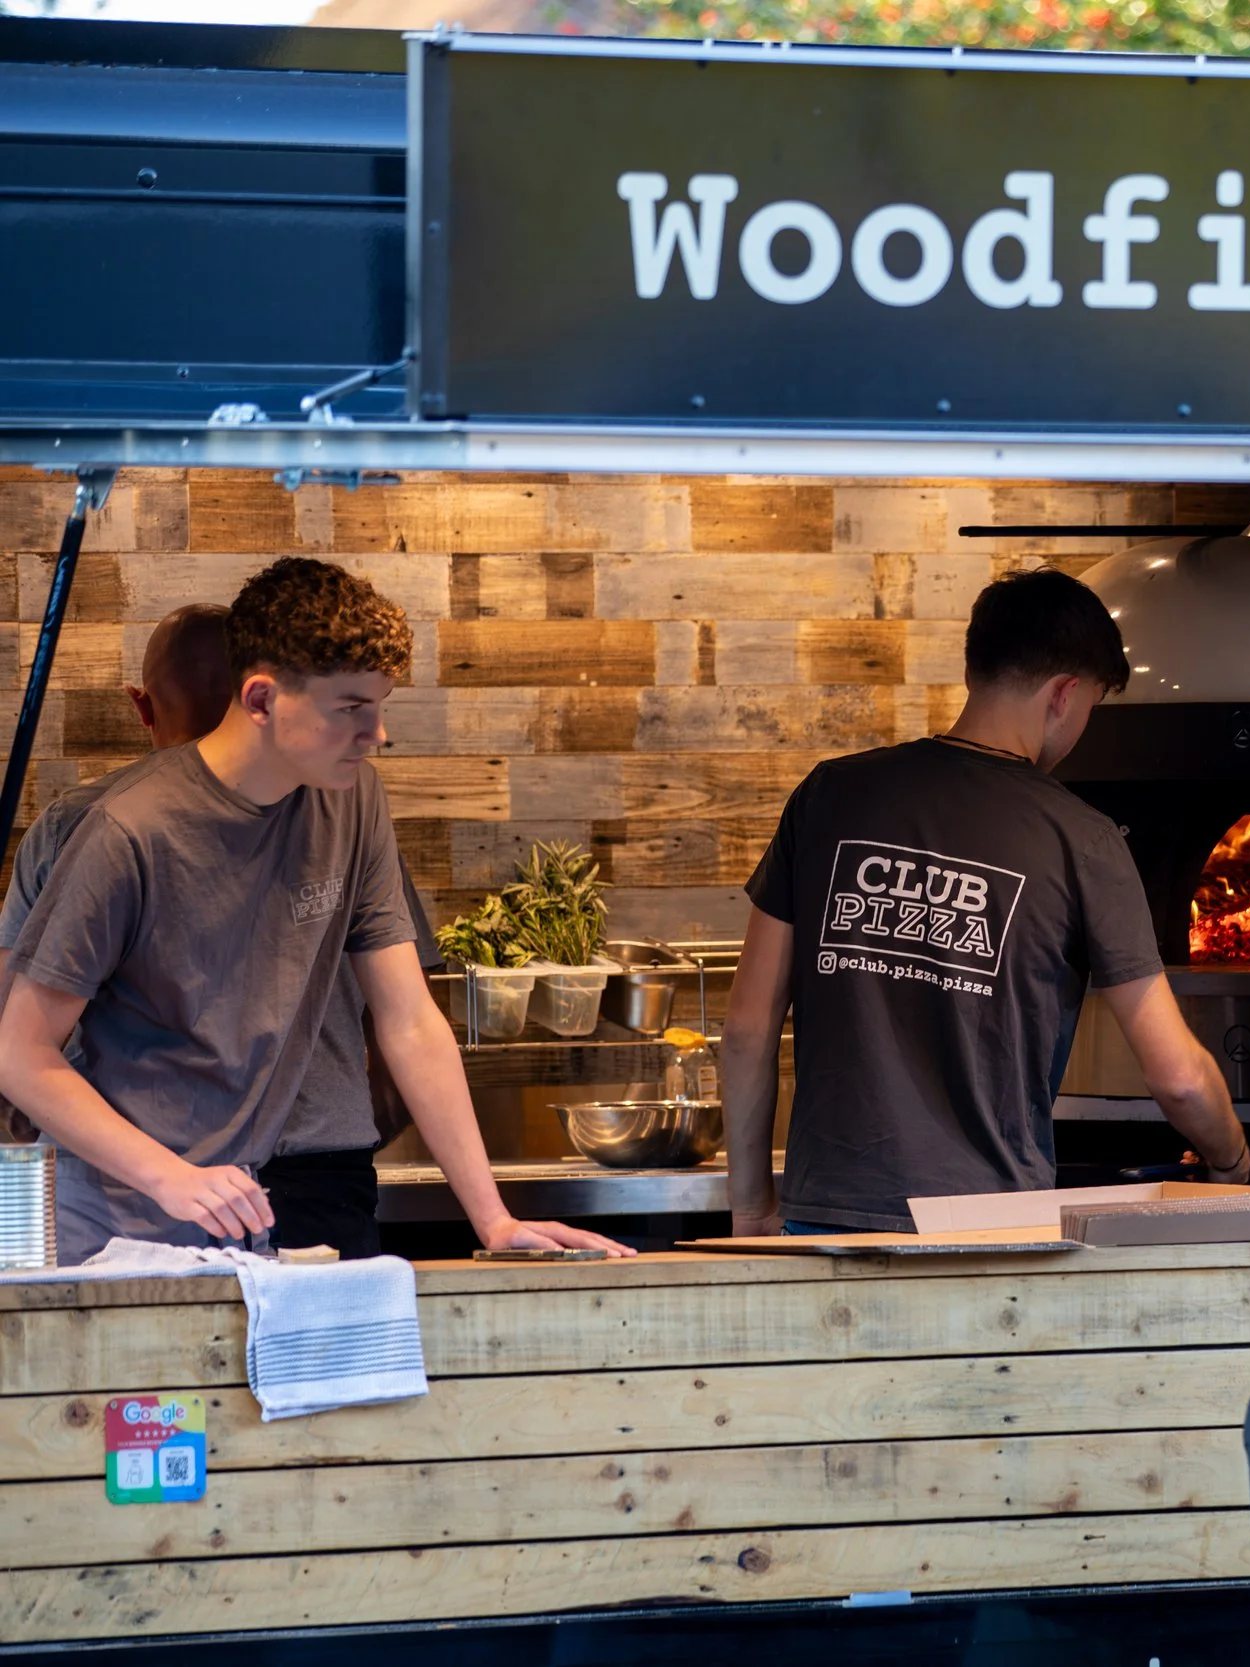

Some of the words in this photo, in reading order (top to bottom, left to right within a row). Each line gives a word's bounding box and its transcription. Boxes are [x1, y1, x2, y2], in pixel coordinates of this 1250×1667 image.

[856, 856, 988, 912] CLUB
[831, 893, 994, 956] PIZZA
[839, 957, 993, 997] @club.pizza.pizza
[124, 1401, 185, 1425] Google
